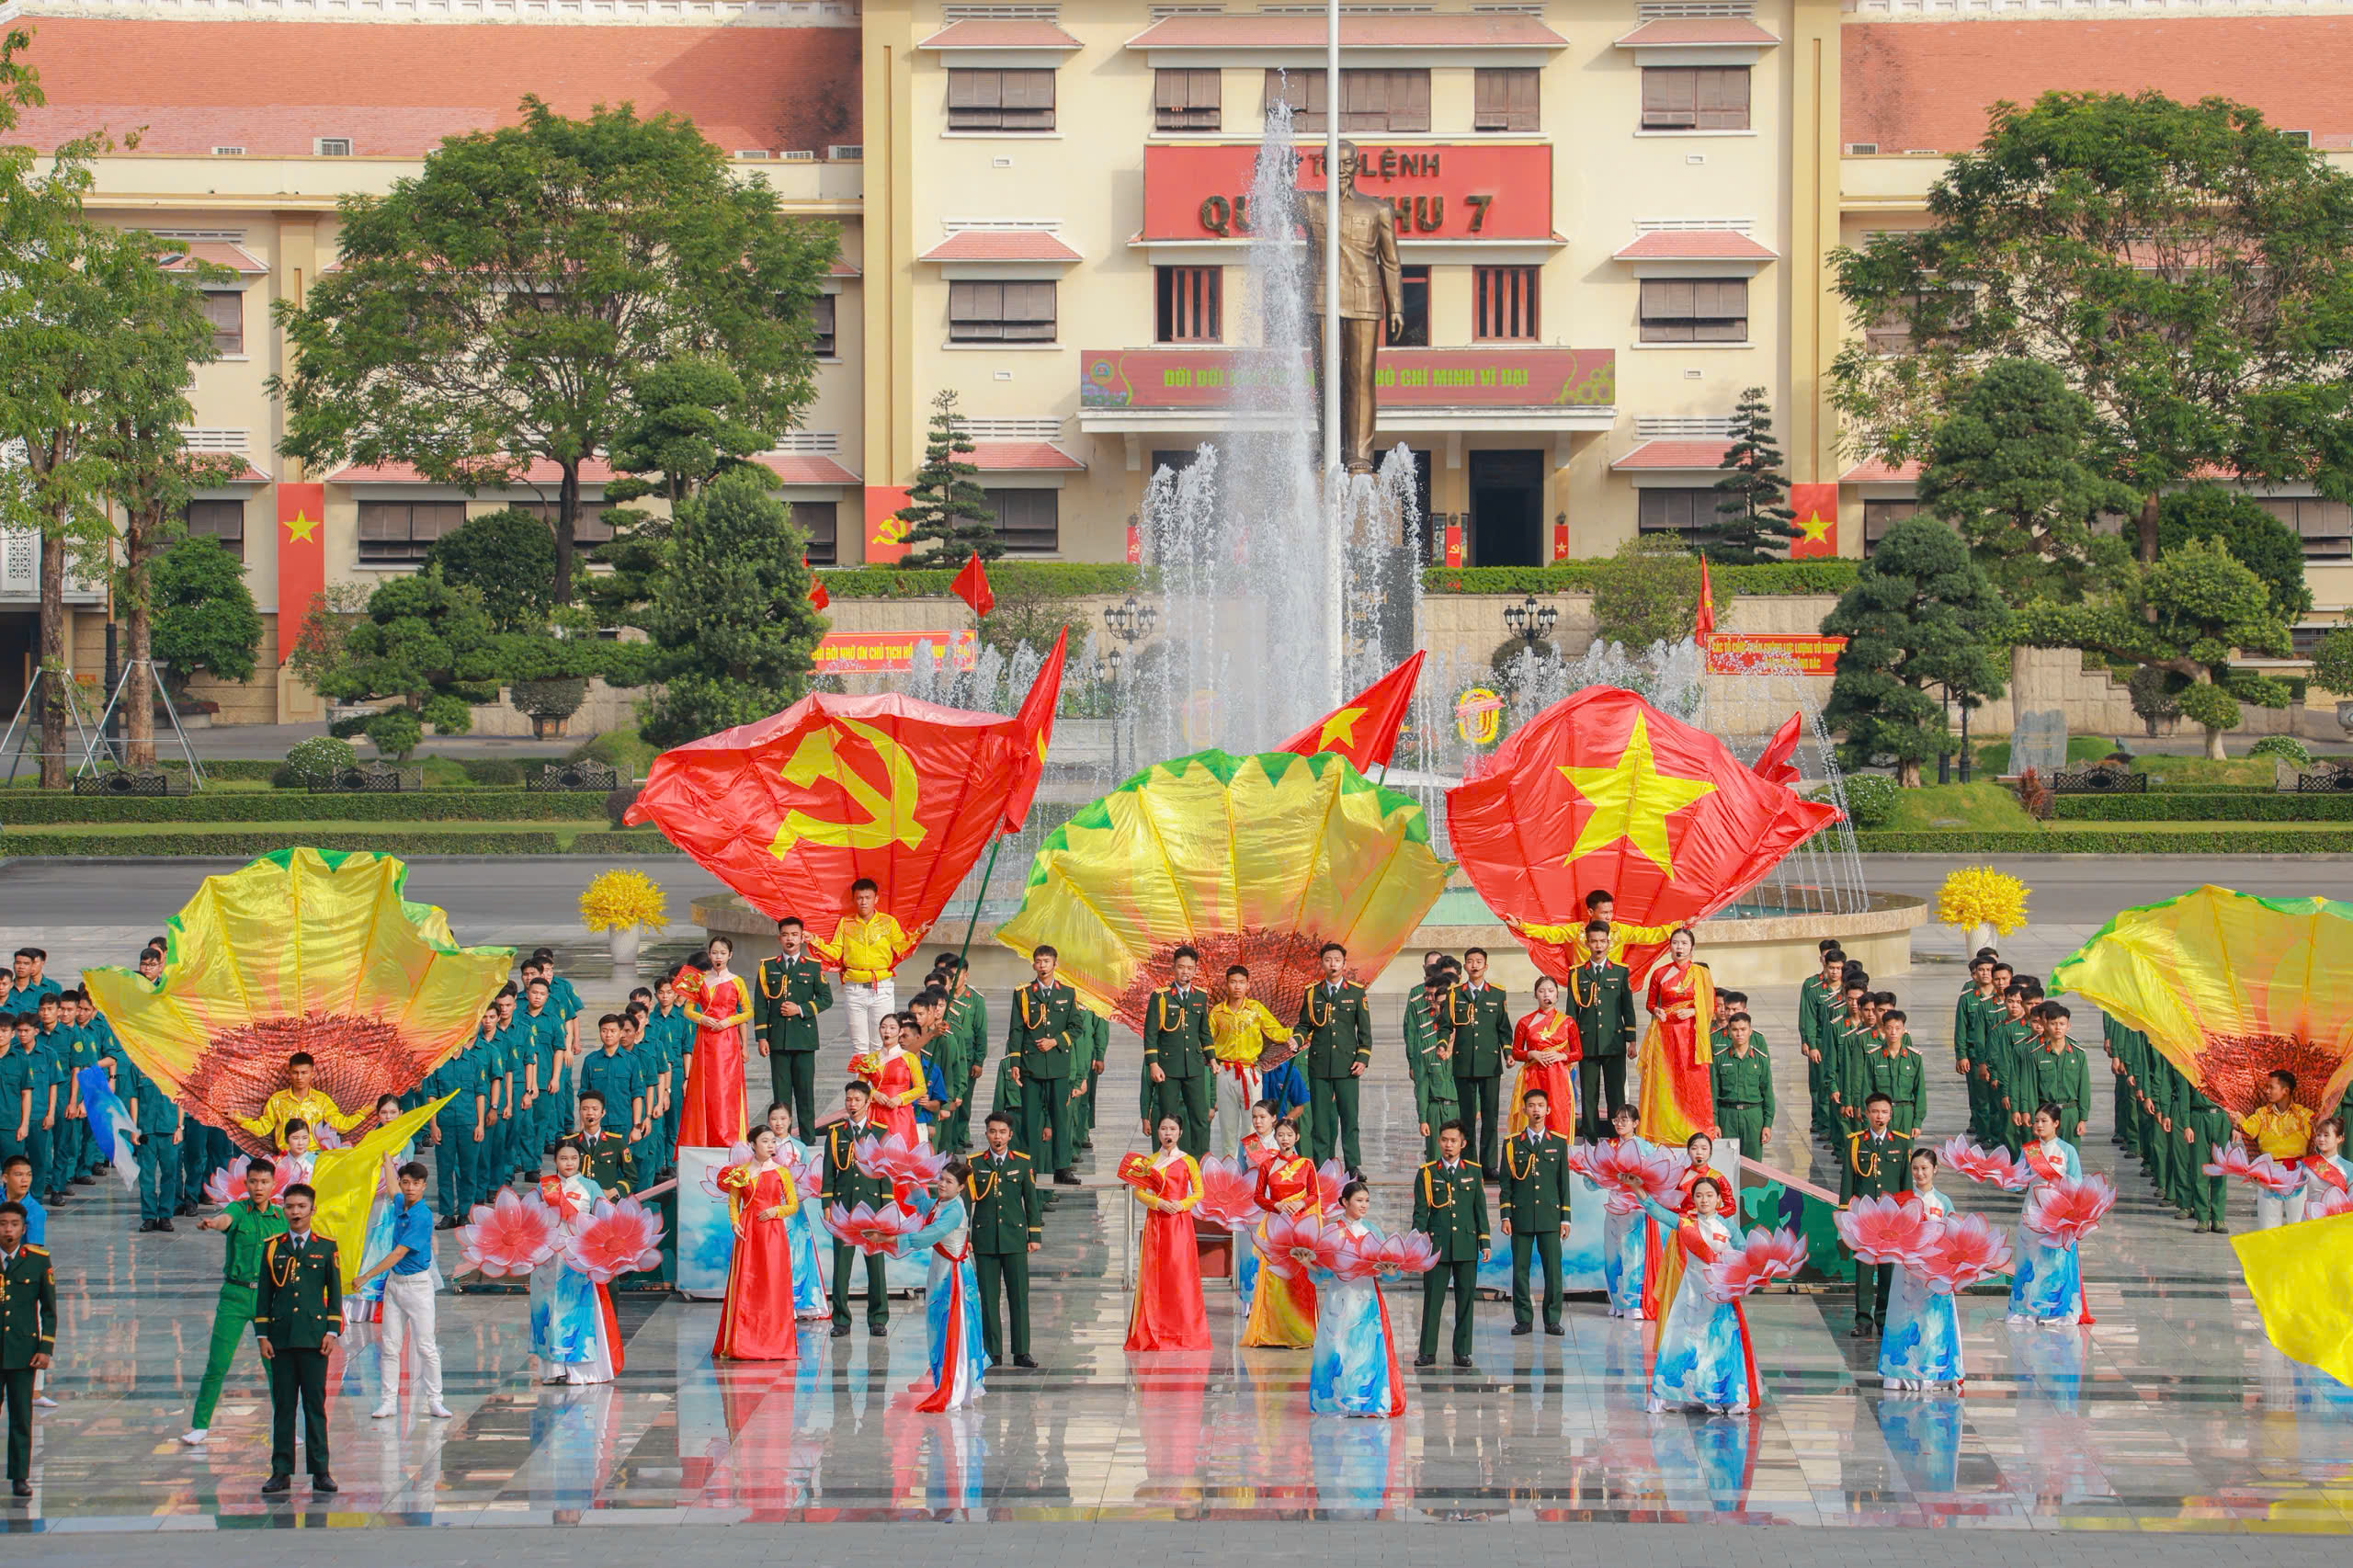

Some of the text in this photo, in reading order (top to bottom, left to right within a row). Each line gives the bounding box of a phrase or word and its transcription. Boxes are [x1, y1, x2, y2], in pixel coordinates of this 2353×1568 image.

[1360, 147, 1440, 182] LỆNH
[1377, 195, 1444, 233] HU
[1466, 195, 1494, 233] 7
[1432, 368, 1475, 387] MINH
